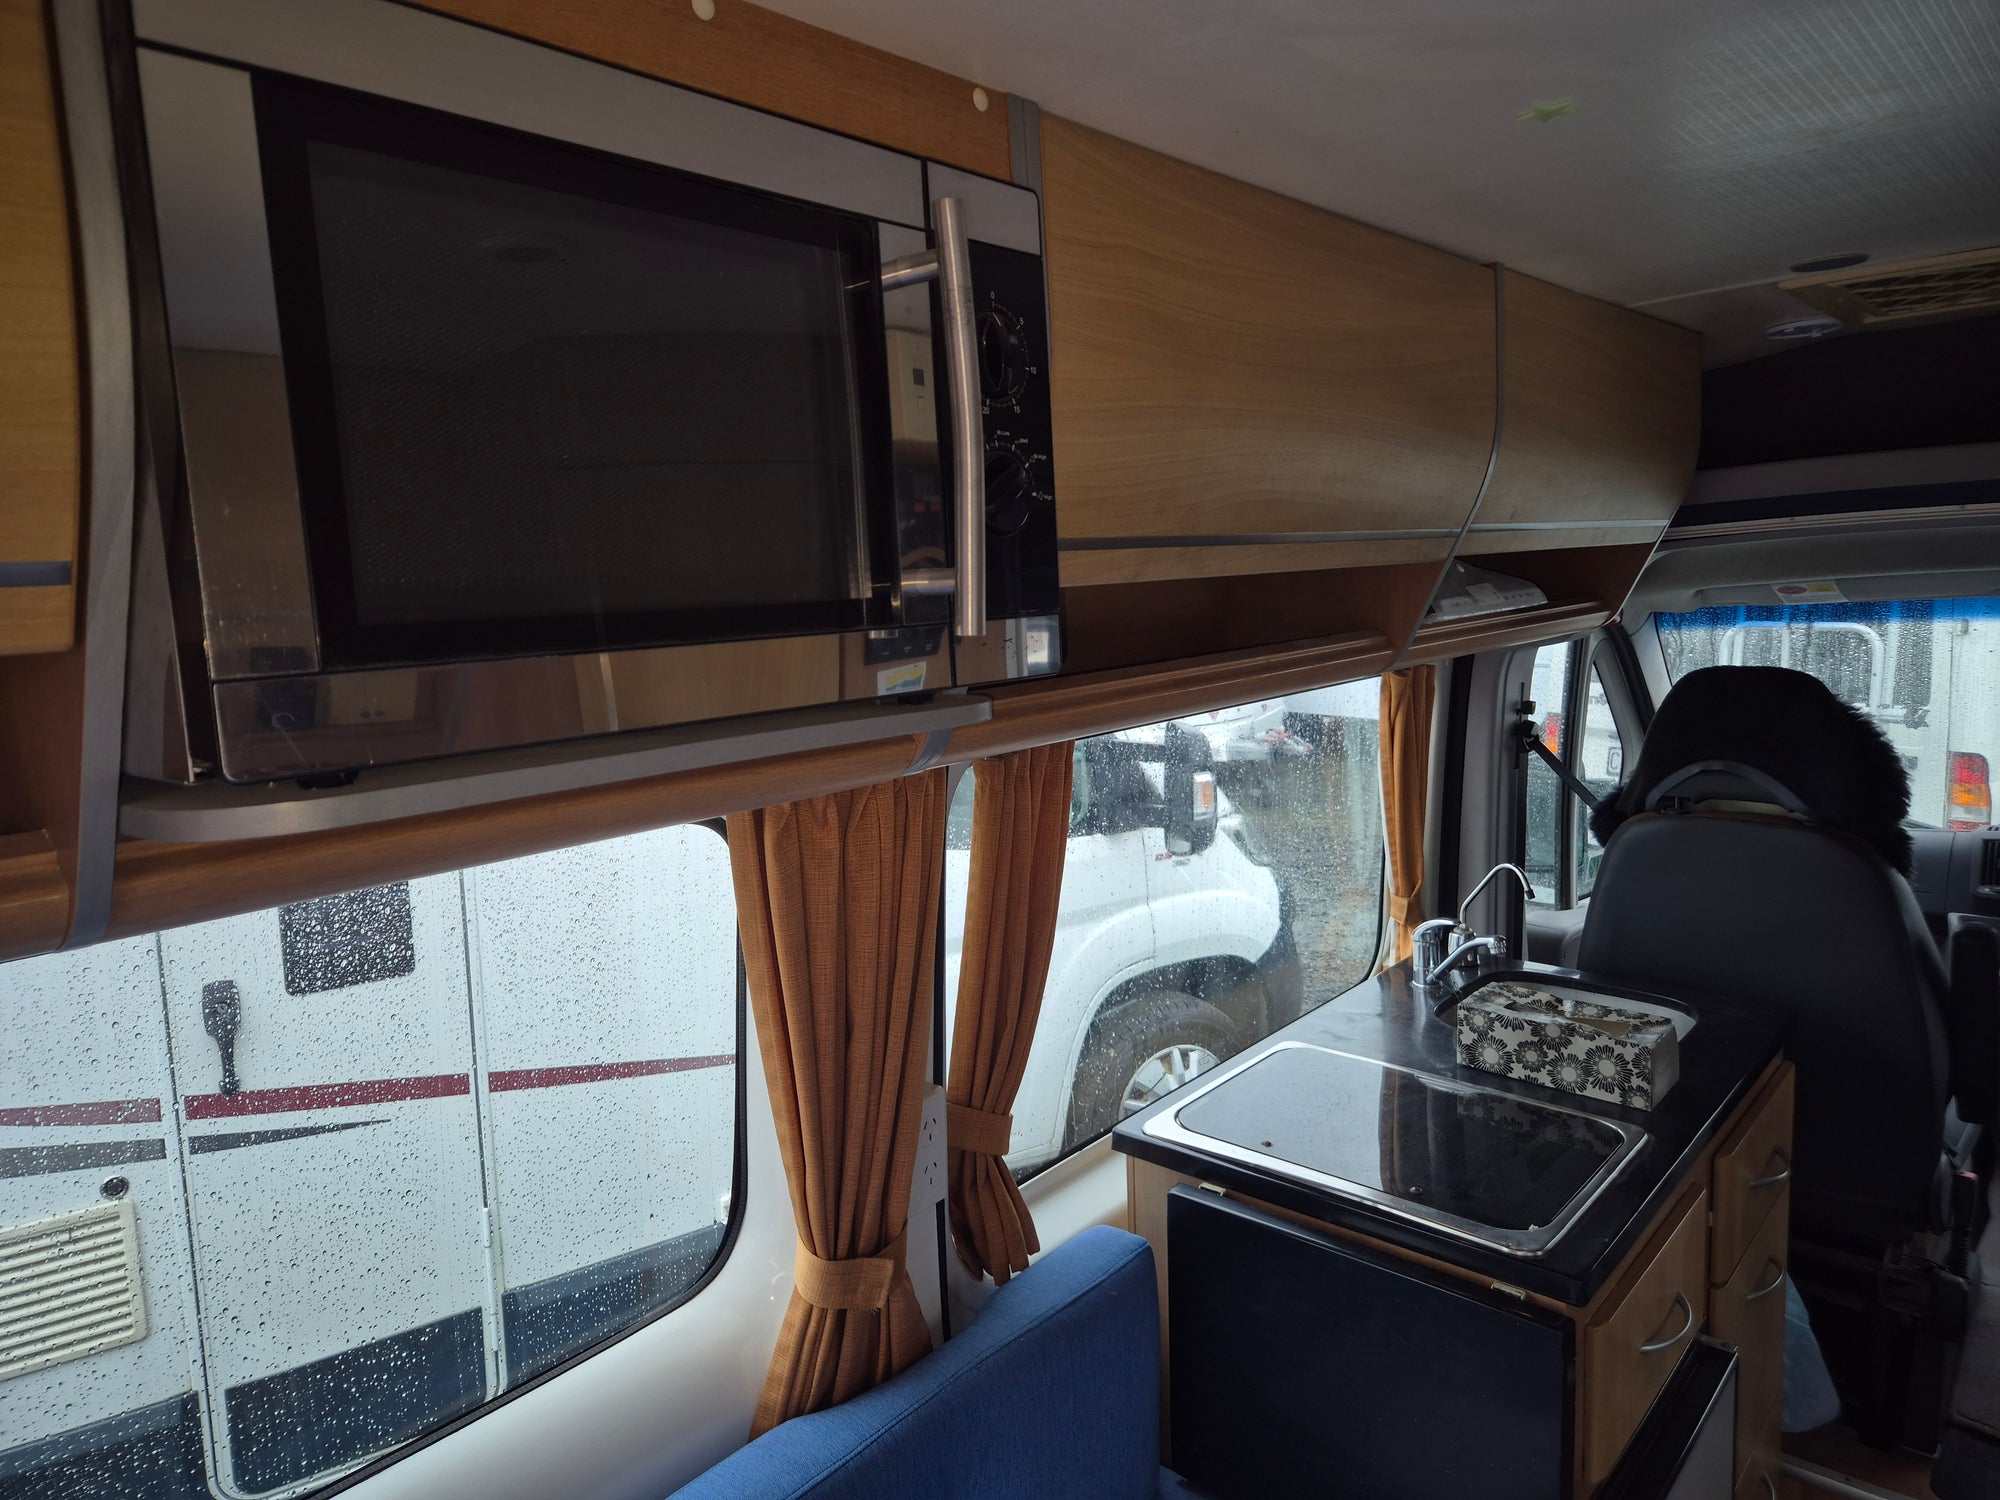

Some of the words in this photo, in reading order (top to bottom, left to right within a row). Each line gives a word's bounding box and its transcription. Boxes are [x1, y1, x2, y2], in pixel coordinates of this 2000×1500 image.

[990, 291, 995, 299] 0
[1019, 317, 1024, 325] 5
[1030, 366, 1037, 374] 10
[982, 406, 990, 414] 20
[1014, 406, 1021, 414] 15
